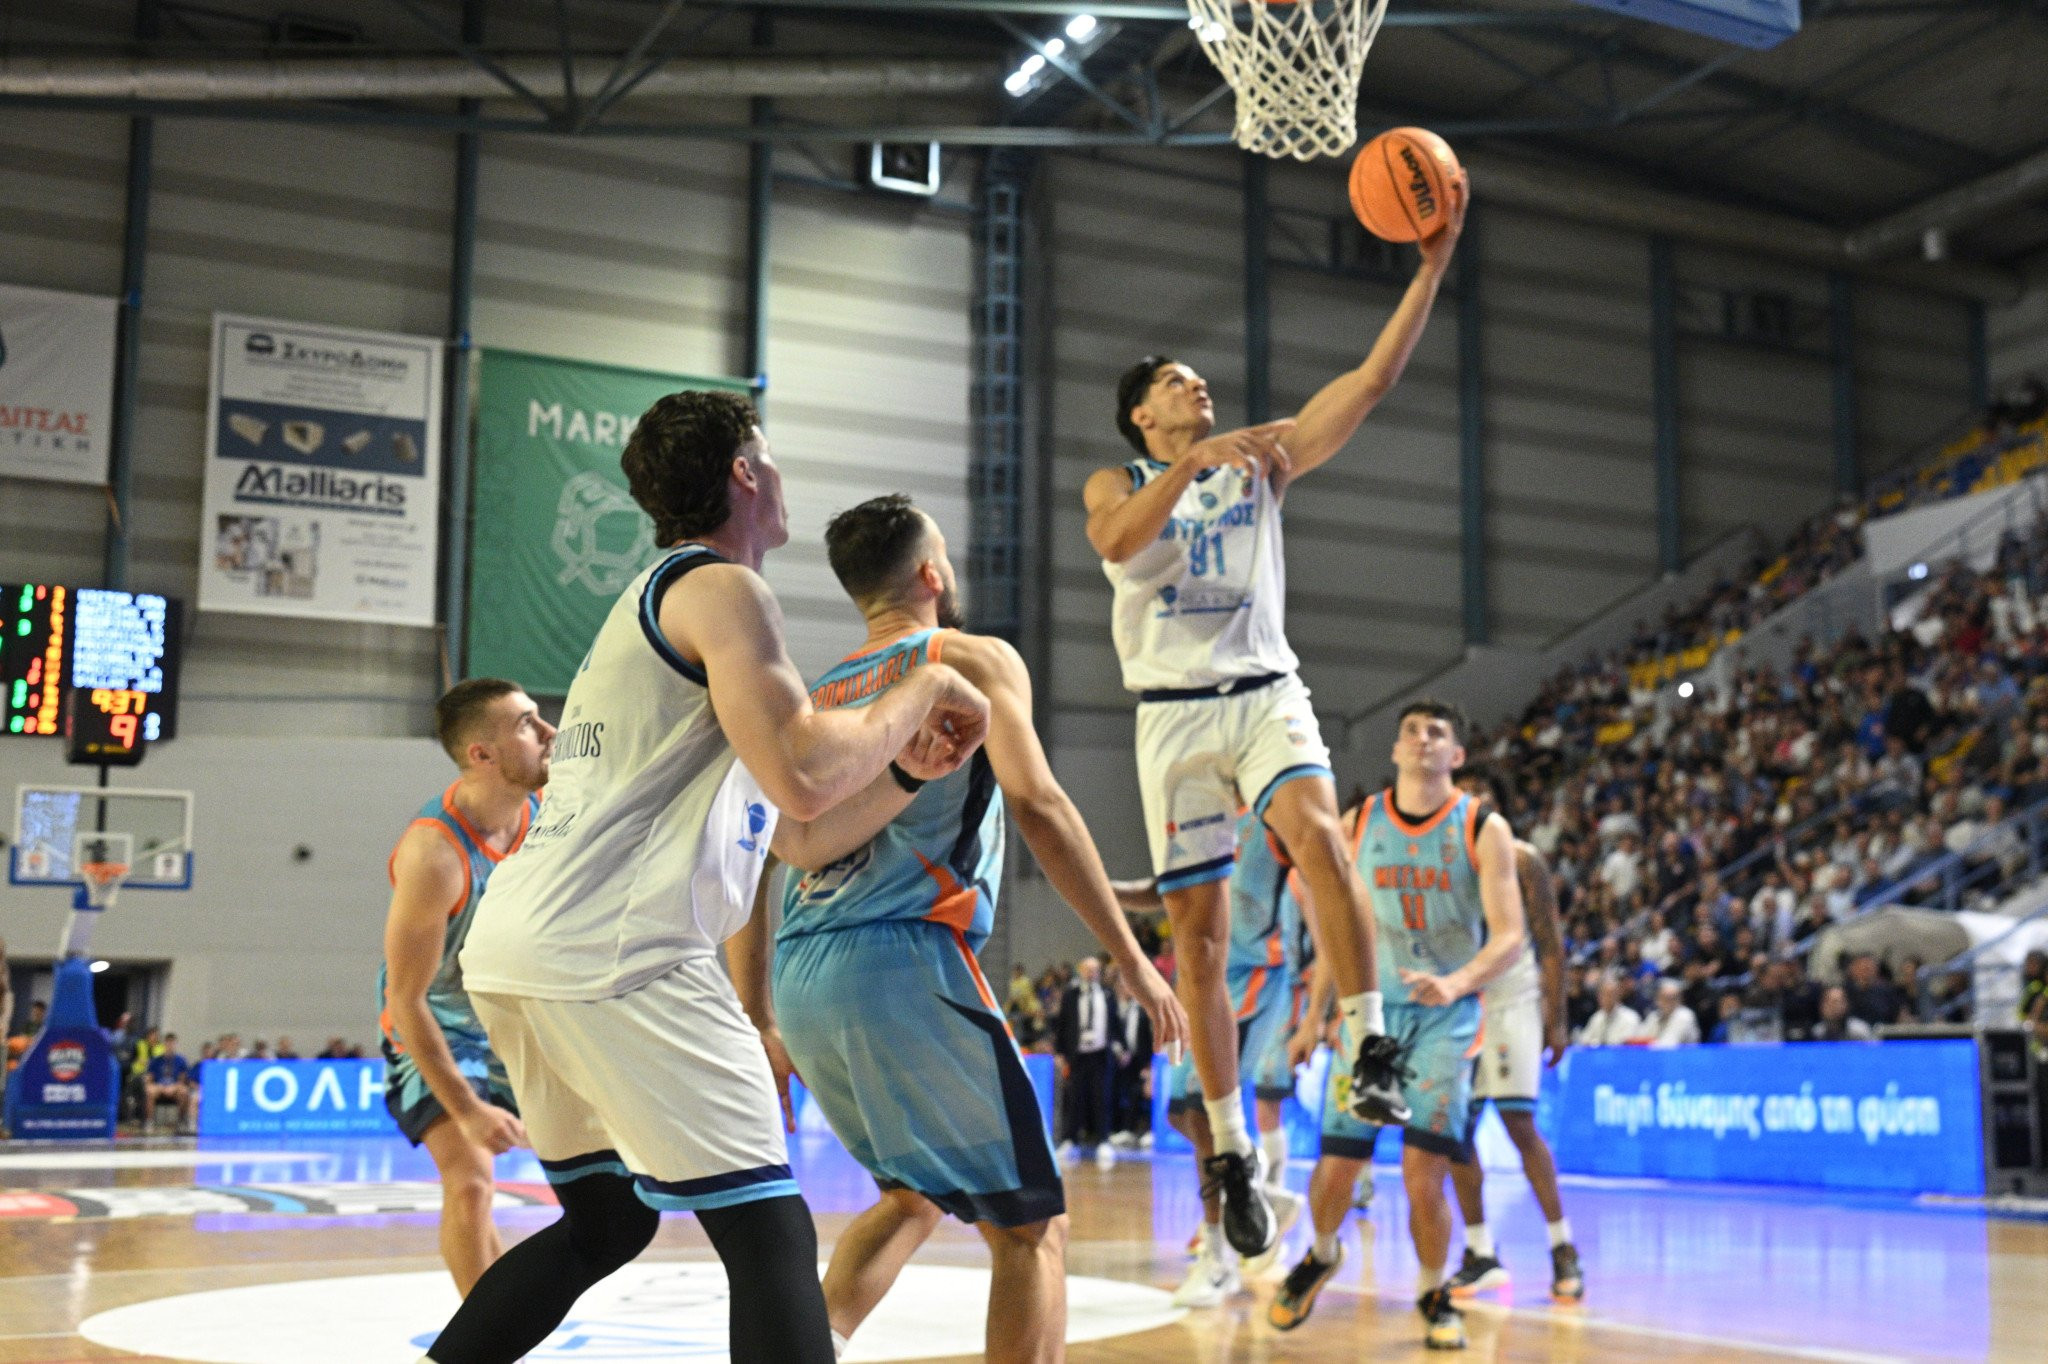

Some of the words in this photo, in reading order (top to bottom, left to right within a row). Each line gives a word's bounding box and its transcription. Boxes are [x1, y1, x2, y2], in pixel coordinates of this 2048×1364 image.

[1401, 143, 1436, 219] Wilson
[236, 464, 406, 505] Malliaris
[1190, 531, 1225, 577] 91
[1593, 1079, 1654, 1137] Πηγή
[1656, 1079, 1762, 1140] δύναμης
[1763, 1080, 1818, 1133] από
[1819, 1095, 1855, 1134] τη
[1857, 1080, 1942, 1146] φύση
